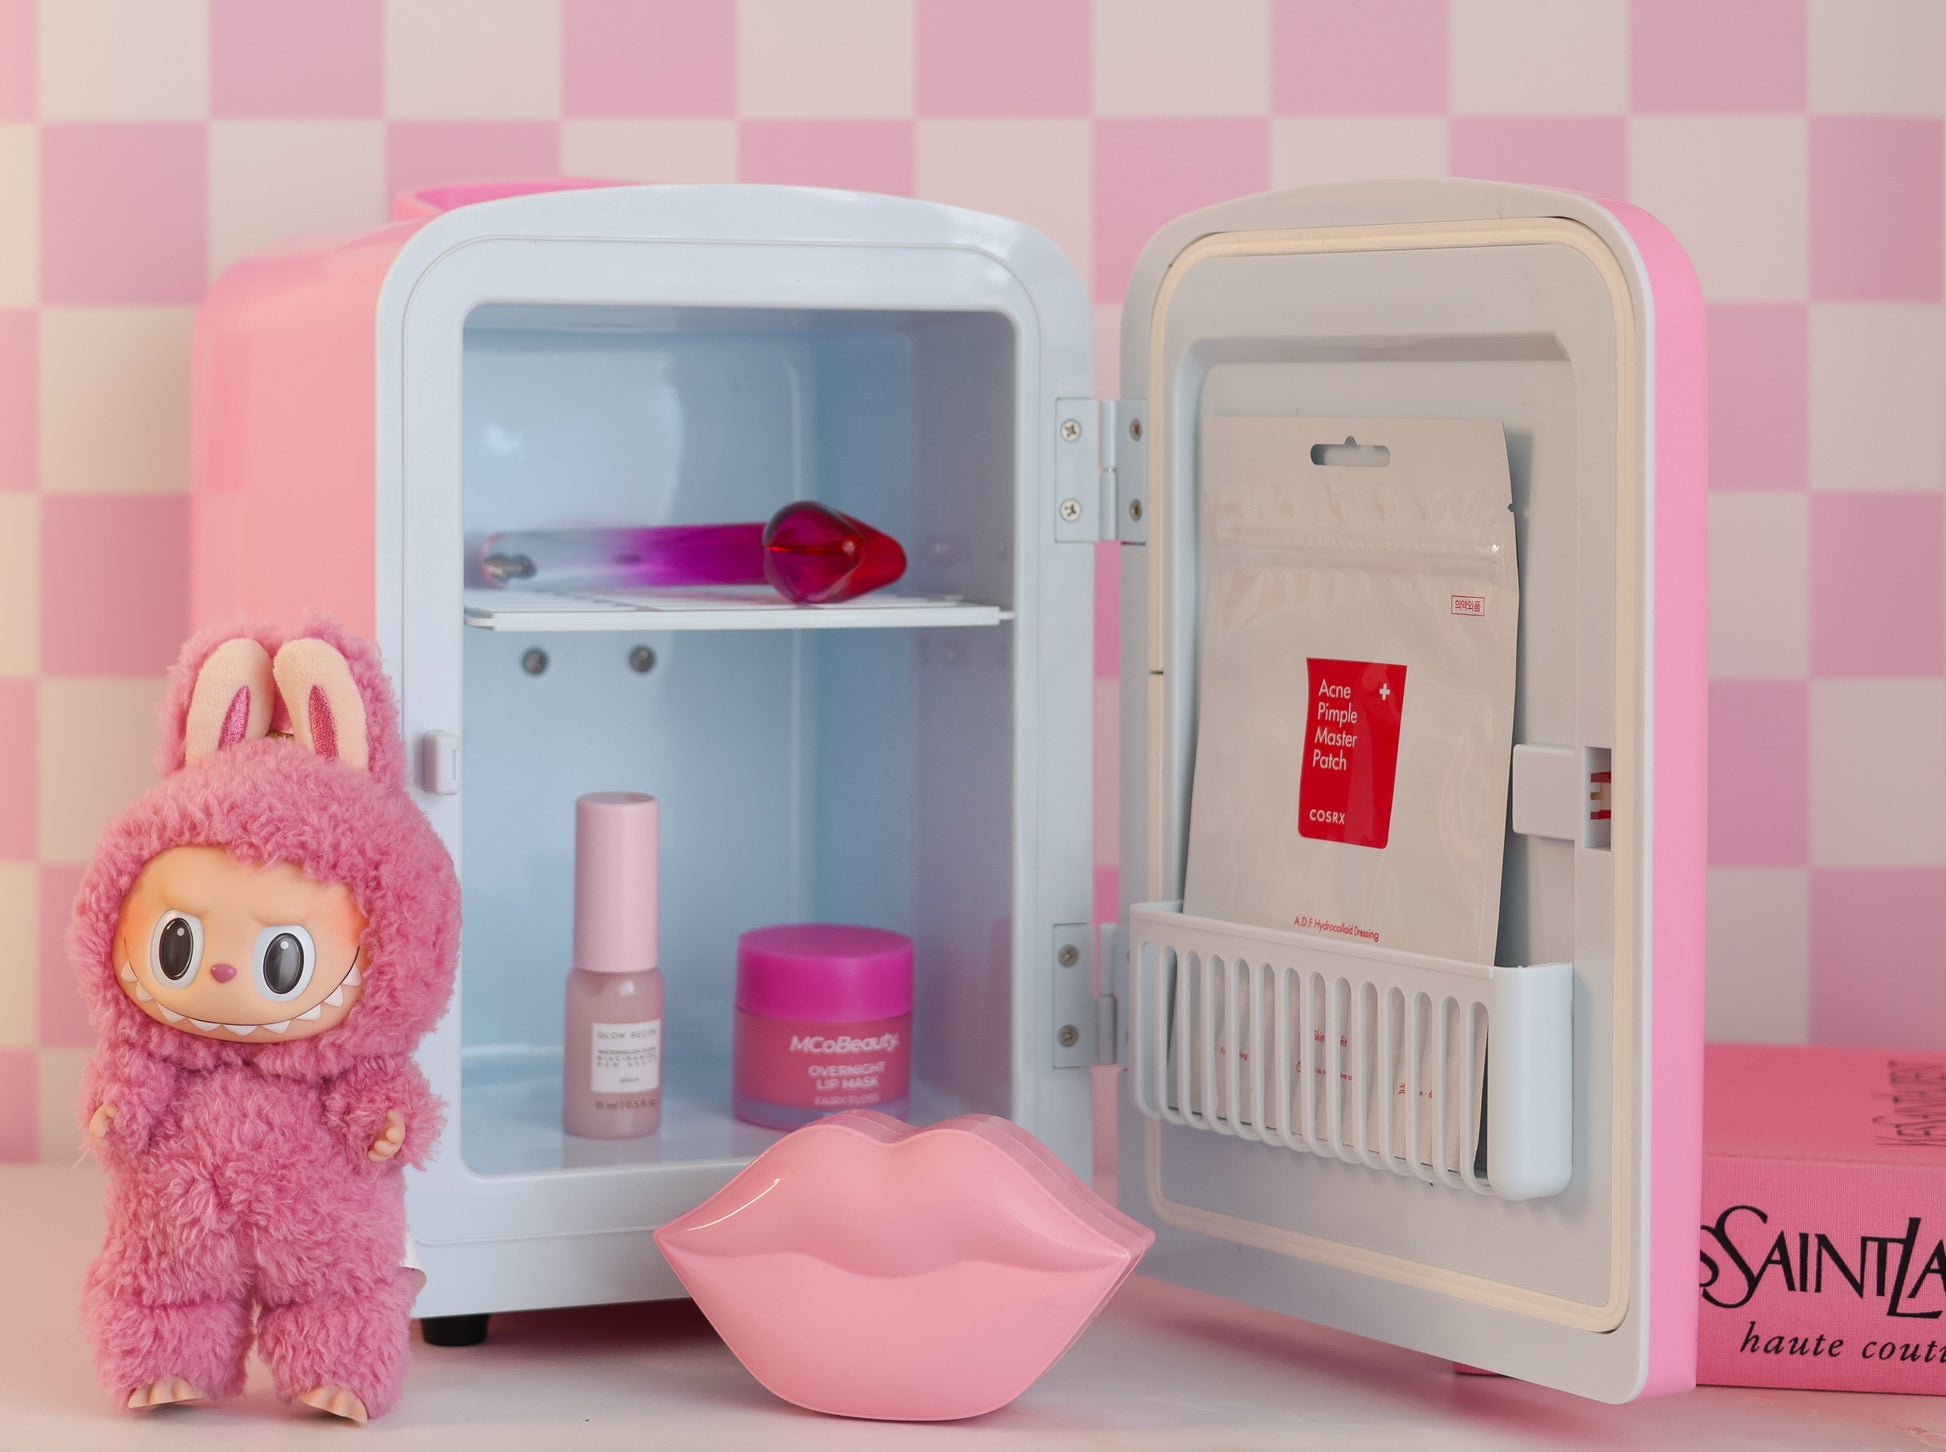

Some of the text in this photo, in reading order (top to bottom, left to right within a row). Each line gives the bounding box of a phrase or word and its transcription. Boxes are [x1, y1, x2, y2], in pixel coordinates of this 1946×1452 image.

[1455, 599, 1481, 612] 의약외품
[1318, 678, 1351, 699] Acne
[1317, 702, 1358, 728] Pimple
[1314, 726, 1357, 748] Master
[1312, 749, 1347, 771] Patch
[1309, 808, 1345, 824] COSRX
[1314, 918, 1353, 935] Hydrocolloid
[1354, 926, 1379, 942] Dressing
[808, 1061, 886, 1077] OVERNIGHT
[816, 1076, 879, 1090] LIP MASK
[1740, 1321, 1844, 1358] haute
